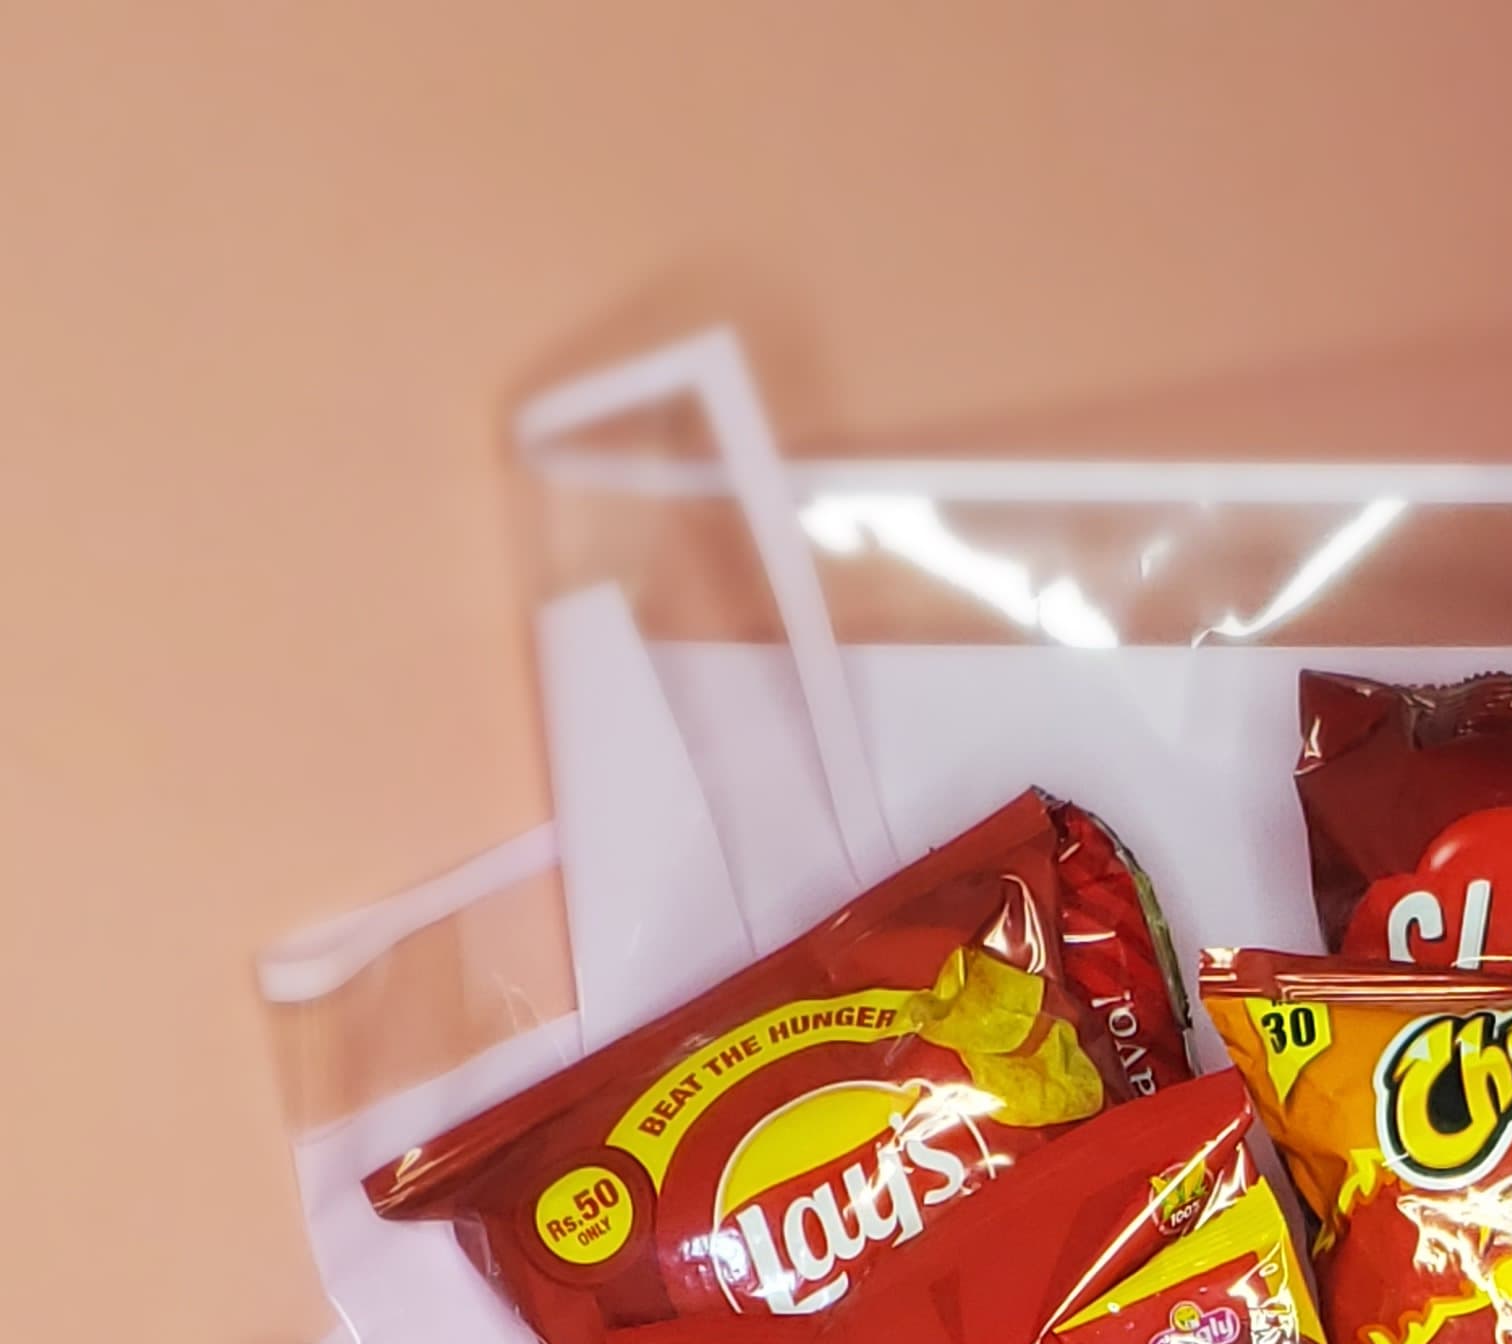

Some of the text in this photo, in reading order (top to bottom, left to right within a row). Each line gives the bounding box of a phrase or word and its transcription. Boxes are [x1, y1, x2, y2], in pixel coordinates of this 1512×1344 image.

[1261, 1007, 1316, 1054] 30
[638, 1007, 897, 1138] BEAT THE HUNGER
[546, 1178, 620, 1243] Rs.50
[578, 1215, 611, 1246] ONLY
